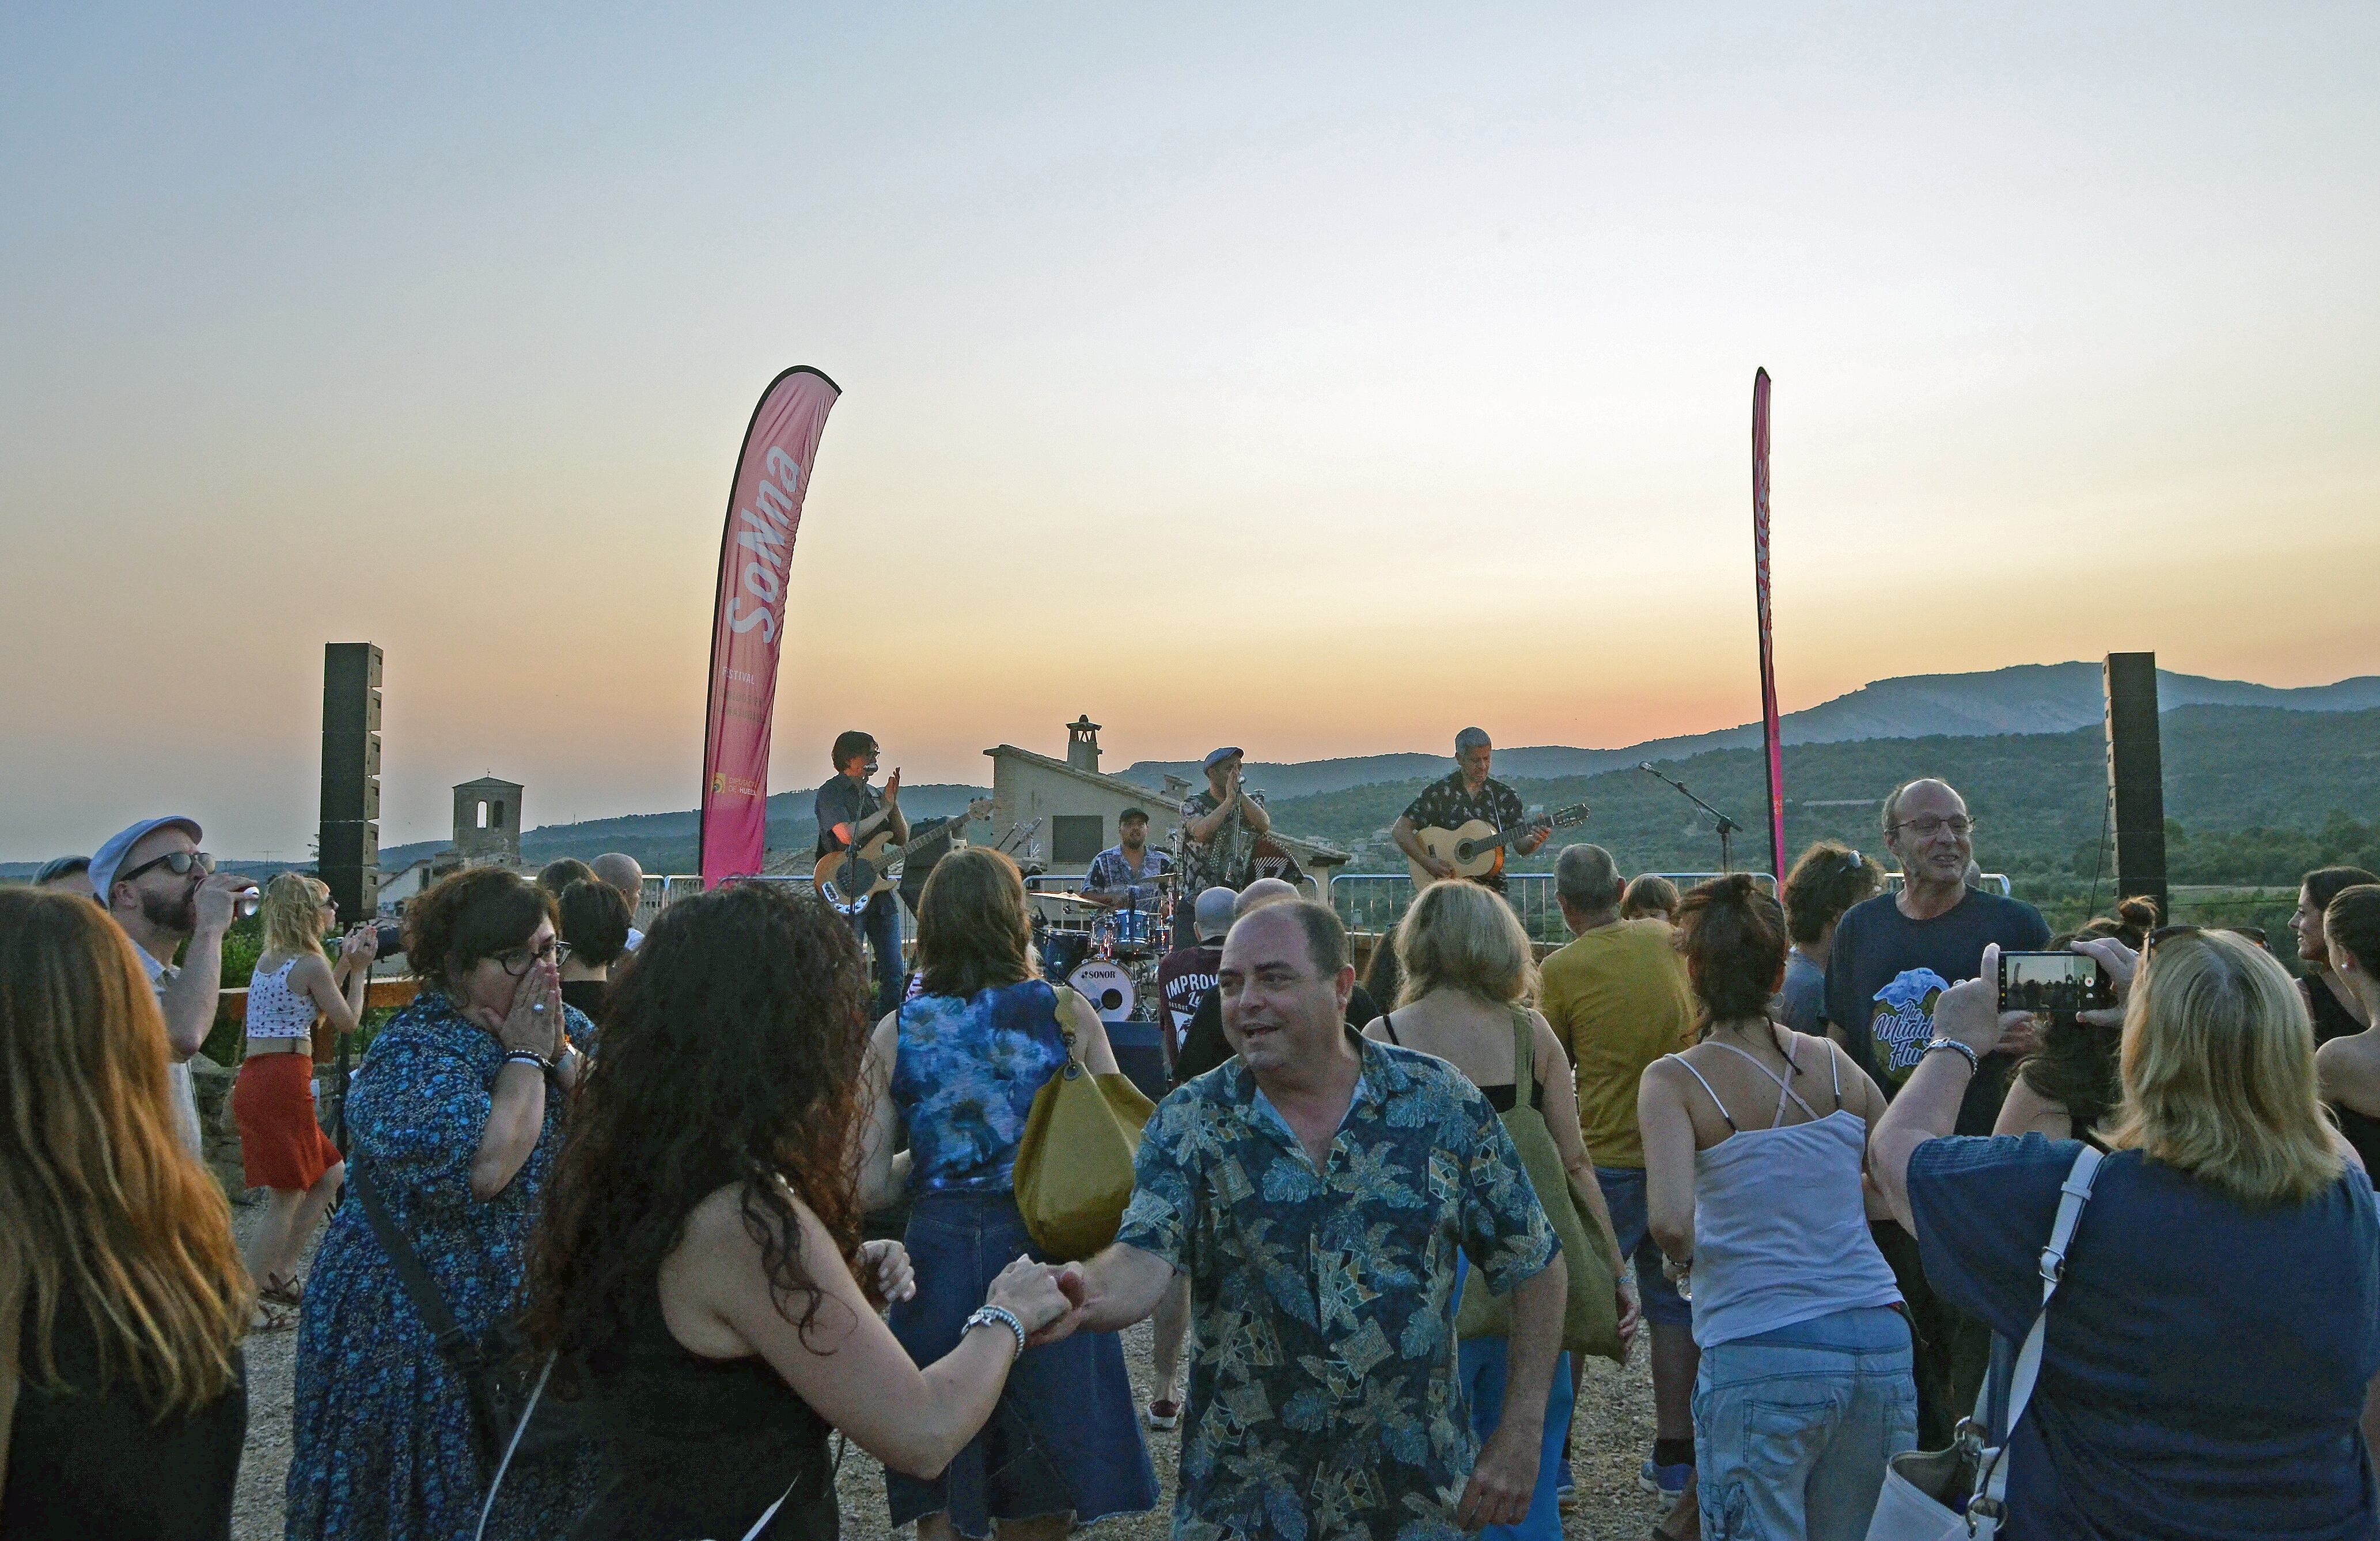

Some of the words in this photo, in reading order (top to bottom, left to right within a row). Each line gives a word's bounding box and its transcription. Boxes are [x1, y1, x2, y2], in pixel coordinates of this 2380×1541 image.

[740, 787, 756, 796] HUES
[1089, 971, 1116, 979] SONOR
[1894, 1000, 1923, 1022] The
